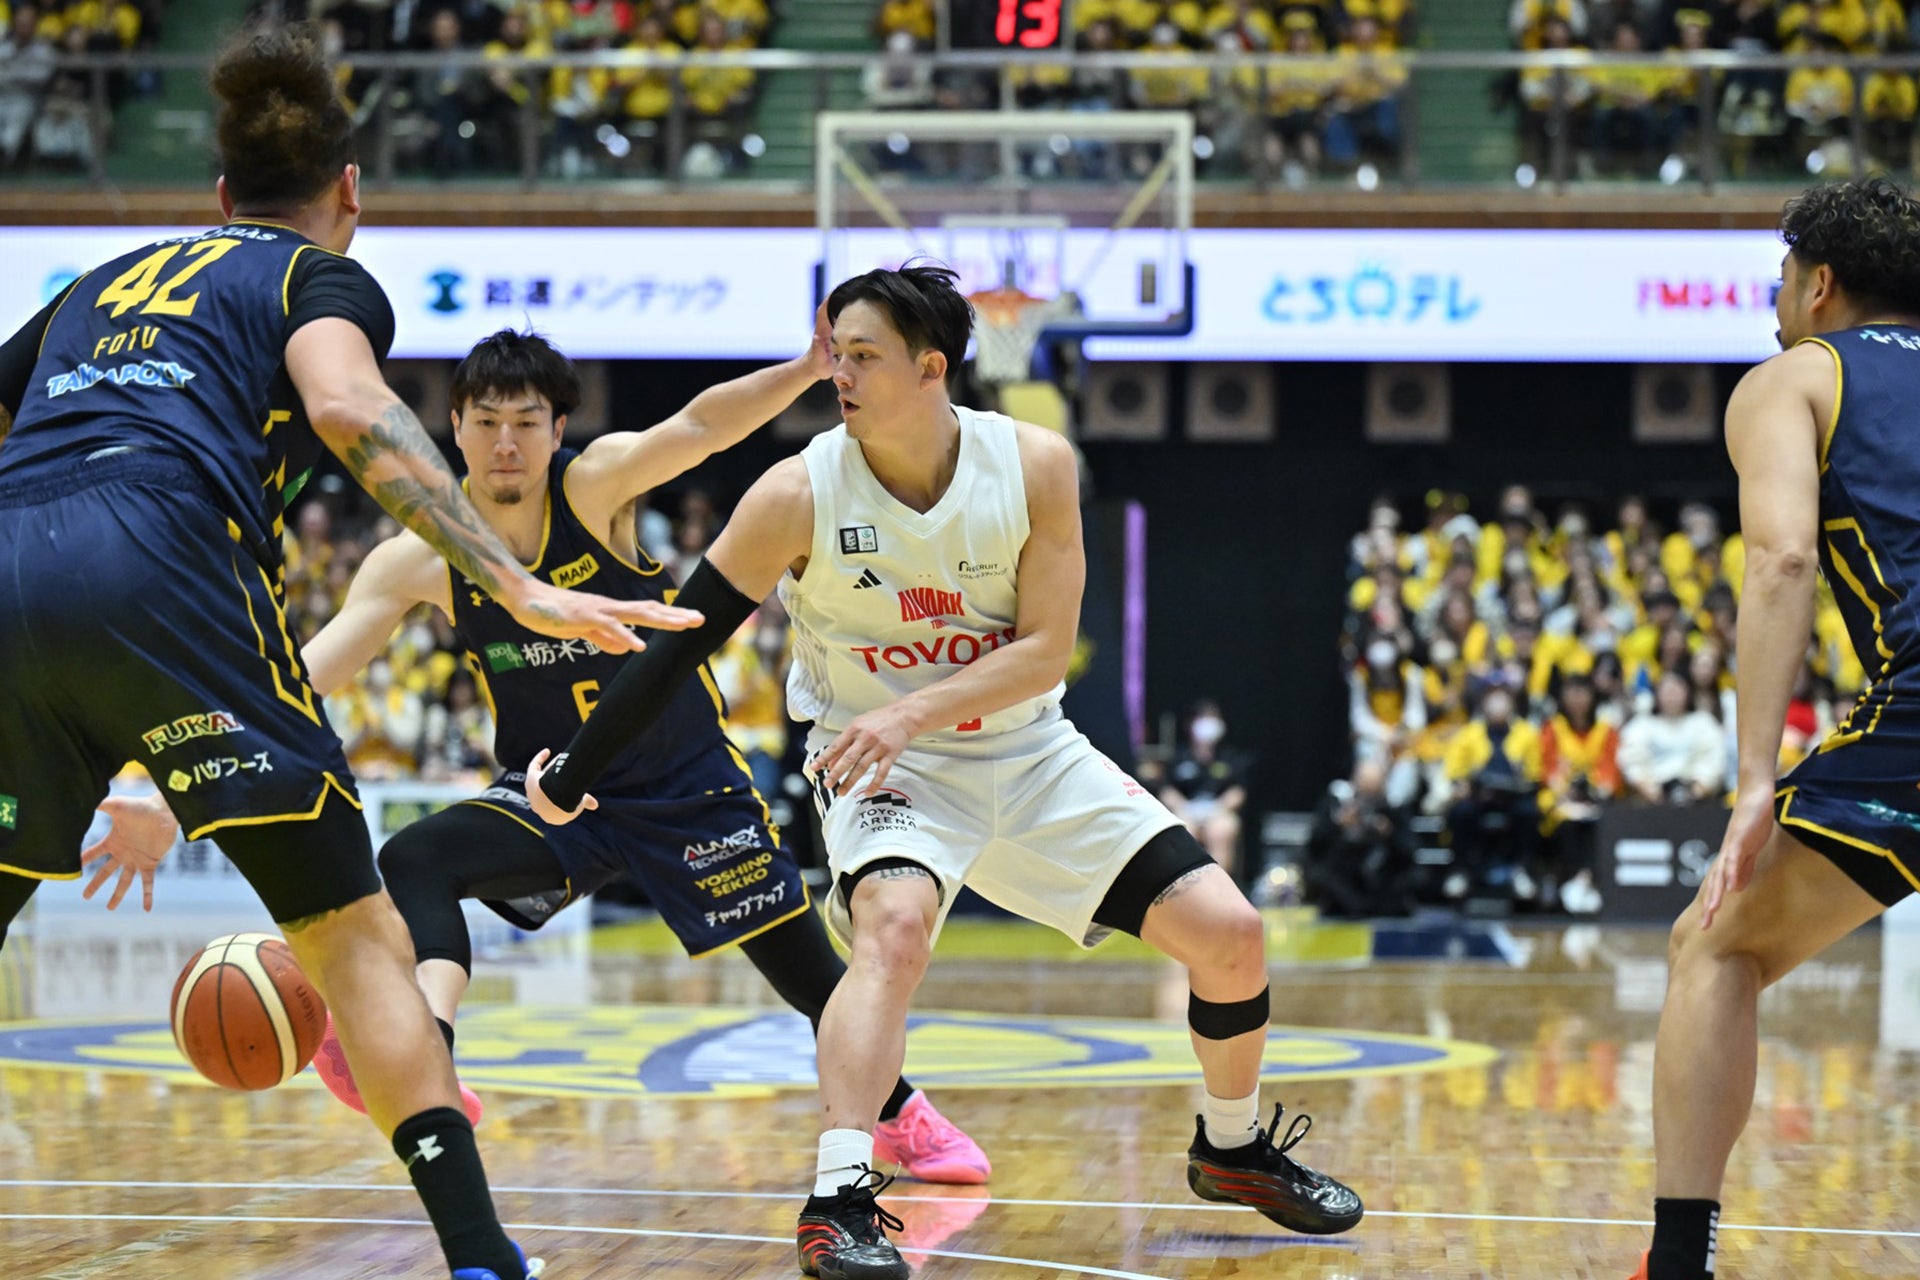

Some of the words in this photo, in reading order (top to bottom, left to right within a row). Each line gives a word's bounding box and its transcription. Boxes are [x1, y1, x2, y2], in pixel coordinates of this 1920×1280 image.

[996, 0, 1062, 48] 13
[95, 238, 242, 318] 42
[93, 326, 161, 359] FOTU
[46, 360, 196, 398] TANAPOLY
[559, 560, 593, 585] MANI
[898, 587, 965, 622] ALVARK
[193, 751, 273, 784] ハガフーズ
[859, 808, 915, 820] TOYOTA
[860, 817, 916, 829] ARENA
[684, 825, 759, 862] ALMEX
[694, 852, 772, 890] YOSHINO
[712, 868, 768, 897] SEKKO
[705, 881, 786, 927] チャップアップ
